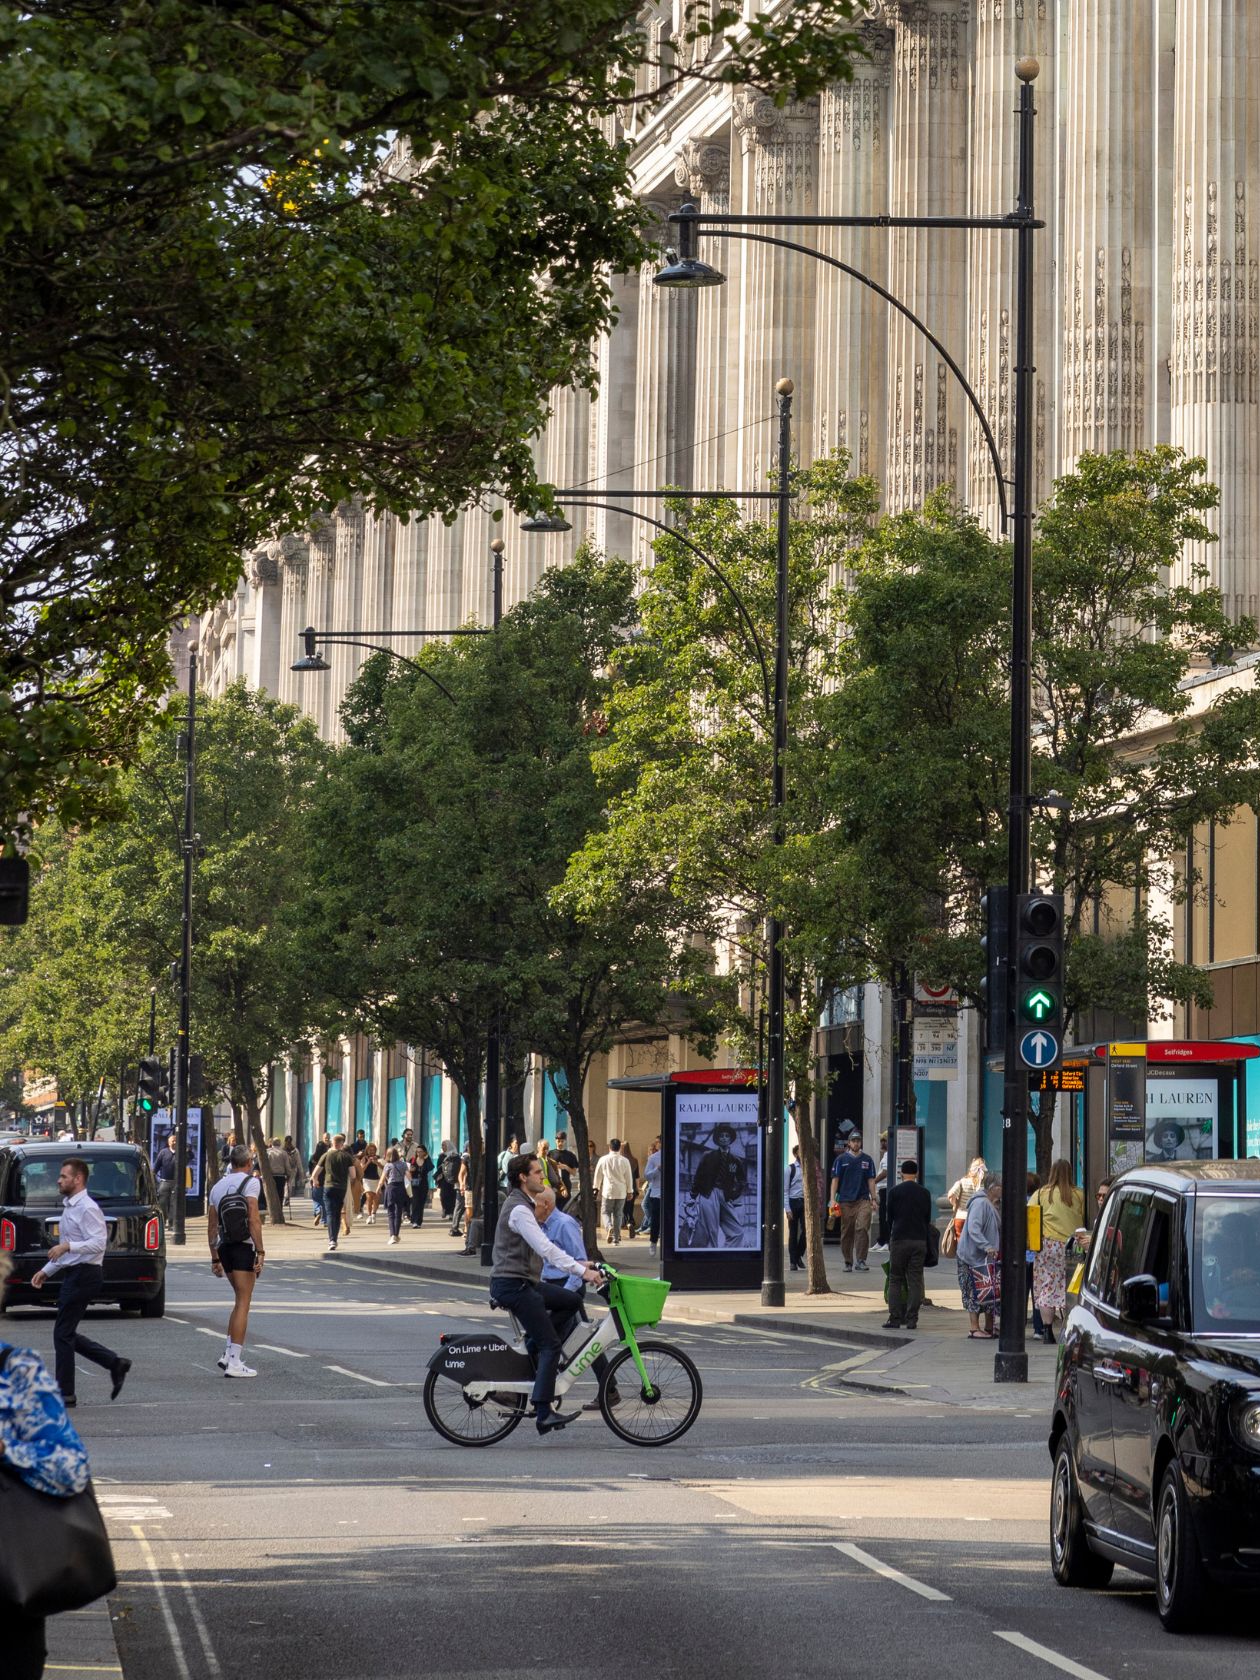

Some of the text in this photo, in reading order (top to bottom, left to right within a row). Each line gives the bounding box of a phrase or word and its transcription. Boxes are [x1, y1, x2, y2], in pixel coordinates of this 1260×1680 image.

[1160, 1092, 1213, 1104] LAUREN
[679, 1103, 758, 1113] RALPH LAUREN
[448, 1346, 461, 1355] On
[462, 1345, 482, 1354] Lime
[488, 1343, 508, 1352] Uber
[568, 1341, 602, 1377] Lime
